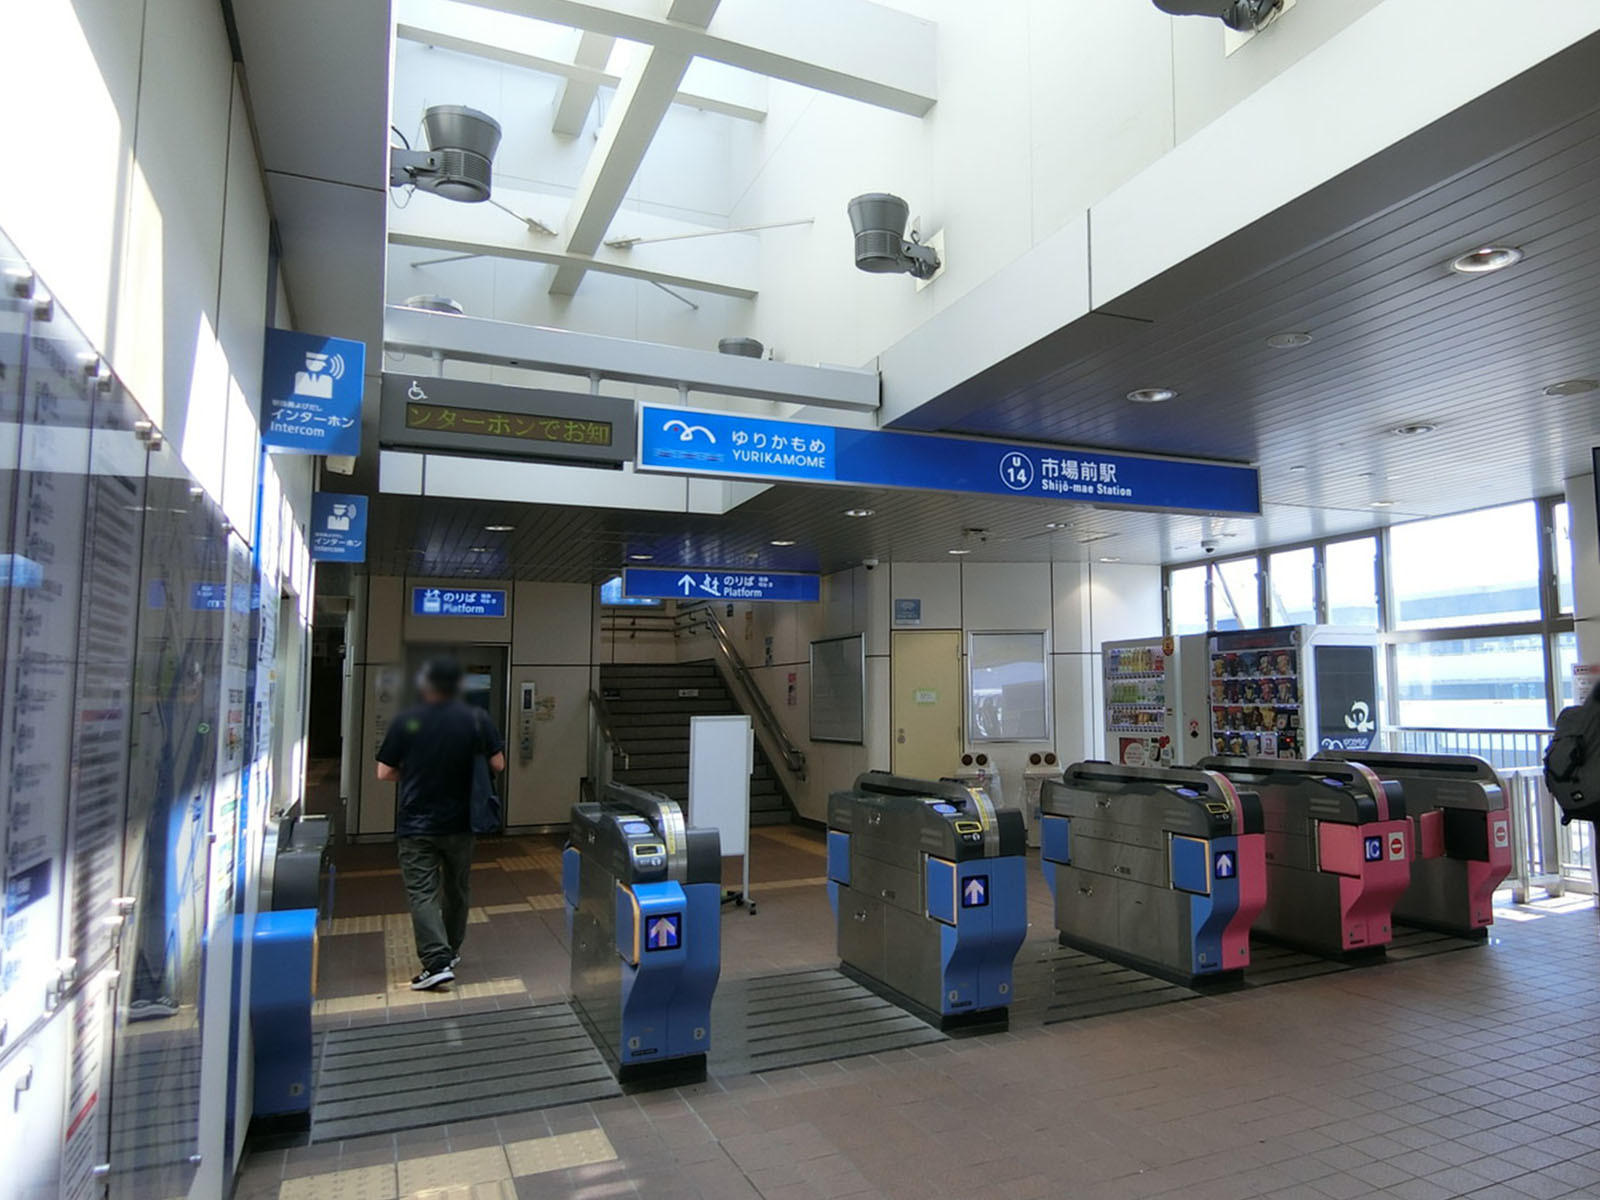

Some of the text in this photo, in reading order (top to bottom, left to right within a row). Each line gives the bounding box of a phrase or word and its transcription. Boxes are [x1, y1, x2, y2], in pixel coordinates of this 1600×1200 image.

[272, 408, 354, 428] インターホン
[409, 407, 610, 444] ンターホンでお知
[270, 421, 325, 437] Intercom
[732, 430, 826, 453] ゆりかもめ
[732, 449, 826, 469] YURIKAMOME
[1012, 456, 1021, 467] U
[1007, 467, 1027, 483] 14
[1041, 458, 1117, 483] 市場前駅
[1096, 483, 1132, 497] Station
[723, 575, 755, 587] のりば
[443, 592, 477, 603] のりば
[723, 586, 763, 597] Platform
[443, 603, 485, 613] Platform
[1365, 841, 1380, 859] IC
